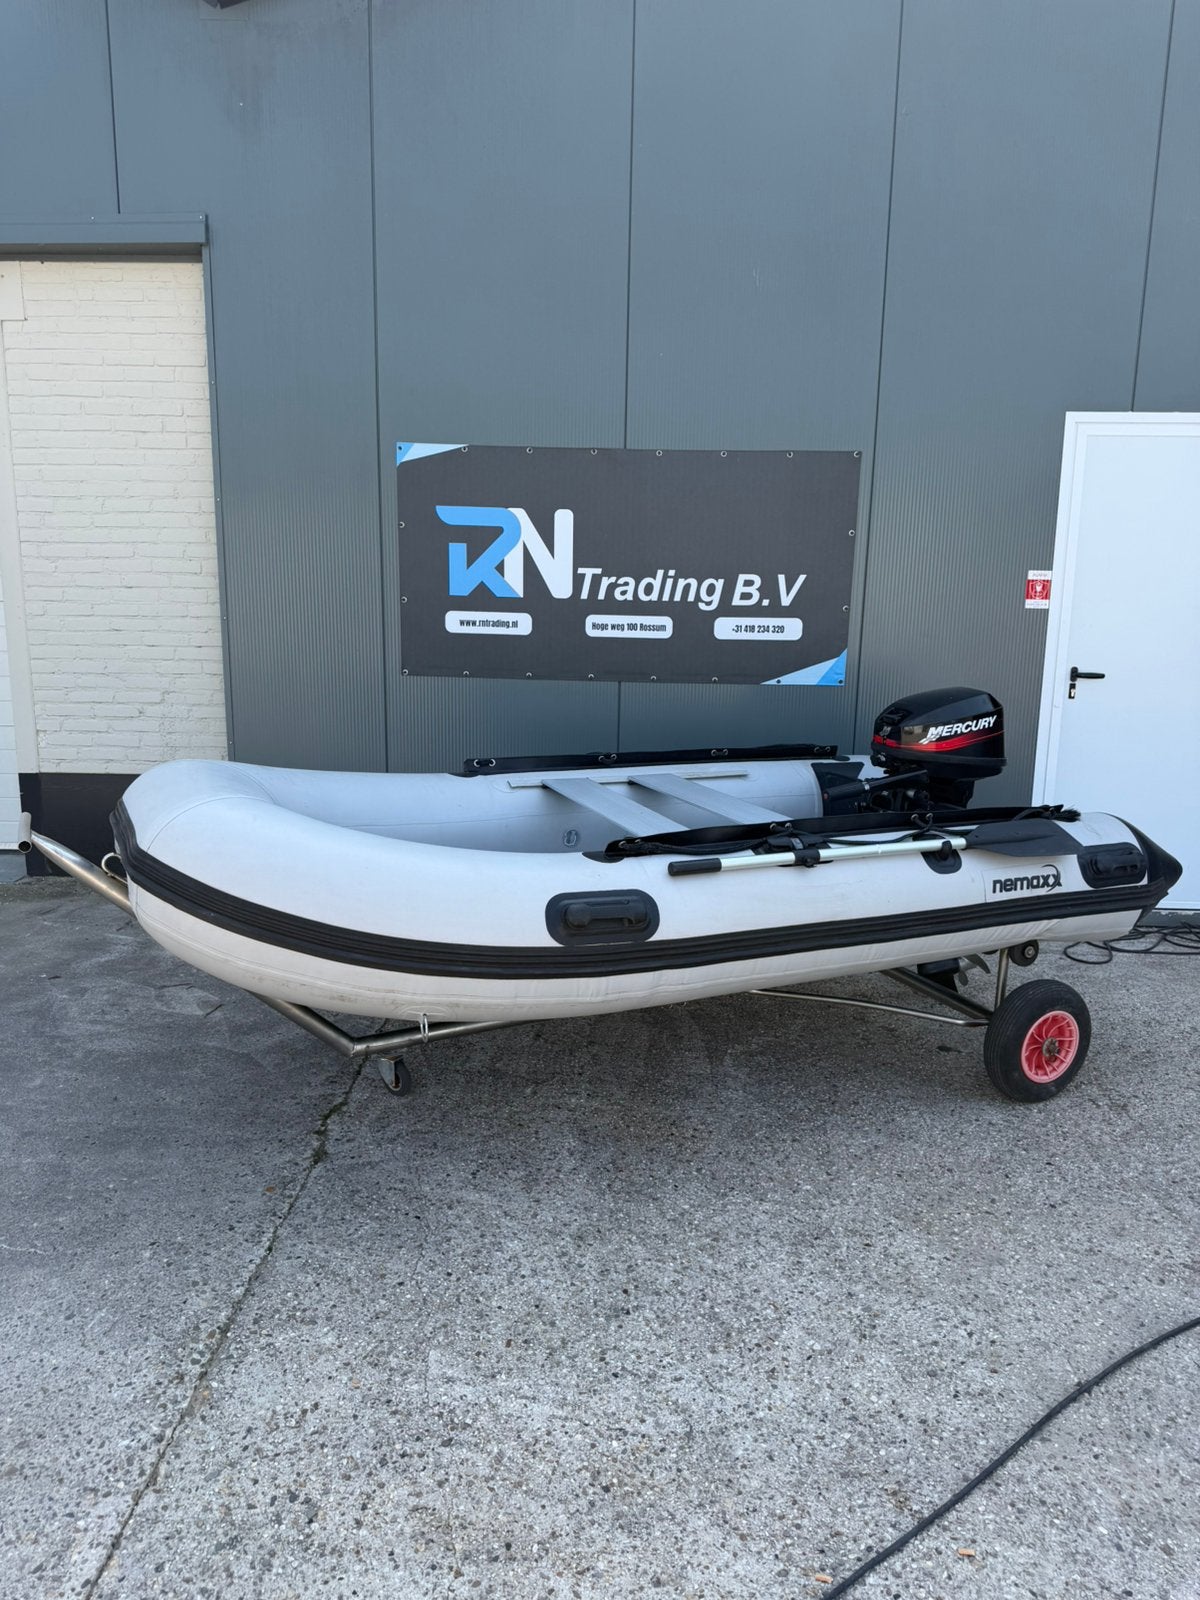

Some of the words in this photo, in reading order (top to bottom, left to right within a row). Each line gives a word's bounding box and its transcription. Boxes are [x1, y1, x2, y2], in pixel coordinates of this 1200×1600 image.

[435, 505, 574, 599] RN
[577, 567, 725, 611] Trading
[731, 573, 808, 607] B.V
[459, 618, 519, 629] www.rntrading.nl
[591, 621, 609, 632] Hoge
[610, 622, 625, 632] weg
[626, 622, 638, 632] 100
[639, 623, 667, 632] Rossum
[743, 624, 756, 633] 418
[757, 624, 770, 634] 234
[771, 625, 785, 634] 320
[918, 715, 998, 745] MERCURY
[992, 872, 1063, 894] nemaxx
